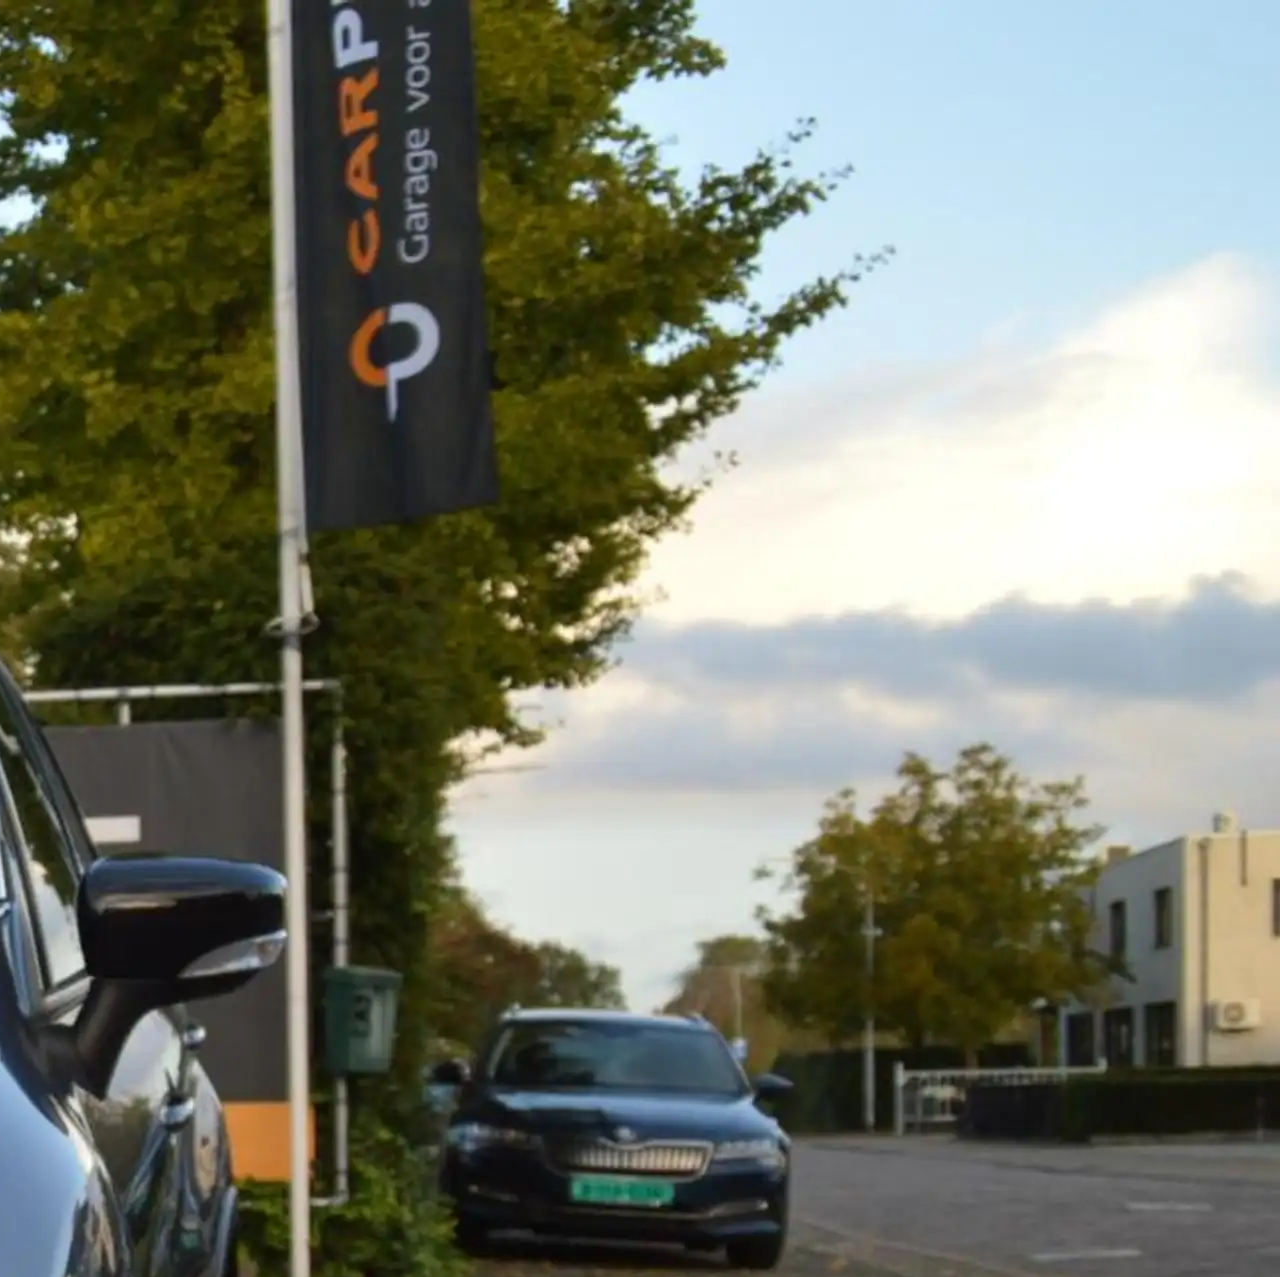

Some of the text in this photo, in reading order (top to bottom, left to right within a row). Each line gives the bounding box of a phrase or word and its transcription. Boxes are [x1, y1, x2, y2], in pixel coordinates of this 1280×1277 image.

[330, 0, 381, 276] CARP
[405, 25, 432, 114] voor
[395, 126, 438, 265] Garage
